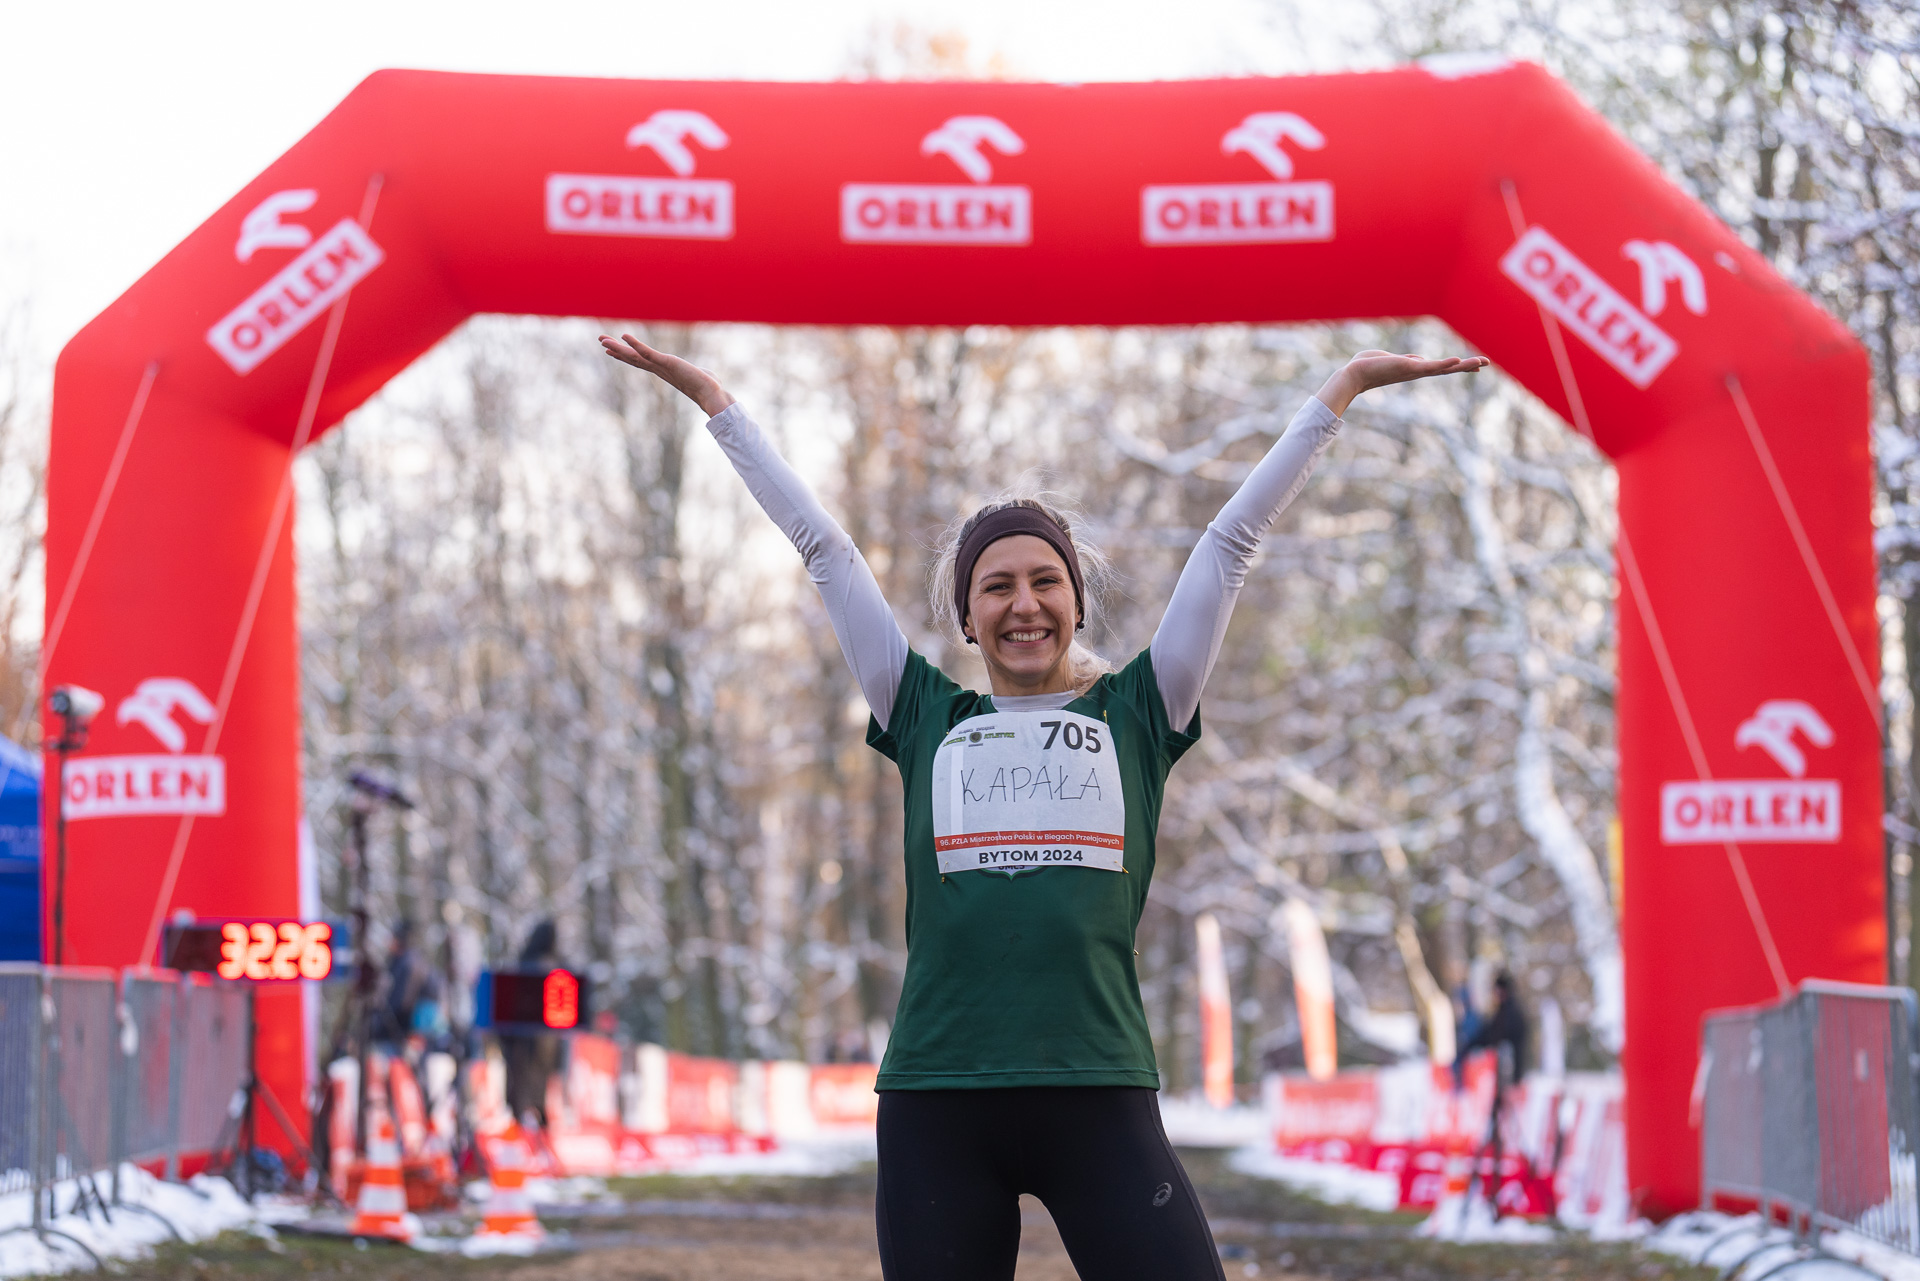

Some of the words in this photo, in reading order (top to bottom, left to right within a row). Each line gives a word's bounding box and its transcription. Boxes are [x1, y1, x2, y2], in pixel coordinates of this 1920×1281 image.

[561, 187, 717, 225] ORLEN
[857, 197, 1013, 231] ORLEN
[1158, 195, 1316, 232] ORLEN
[230, 236, 364, 353] ORLEN
[1522, 247, 1658, 366] ORLEN
[1040, 720, 1102, 754] 705
[70, 768, 210, 804] ORLEN
[960, 765, 1102, 805] KAPAŁA
[1673, 793, 1826, 829] ORLEN
[940, 839, 951, 847] 96.
[951, 837, 969, 845] PZLA
[969, 833, 1013, 843] Mistrzostwa
[1013, 832, 1036, 841] Polski
[1044, 833, 1075, 842] Biegach
[978, 850, 1039, 864] BYTOM
[1042, 849, 1083, 862] 2024
